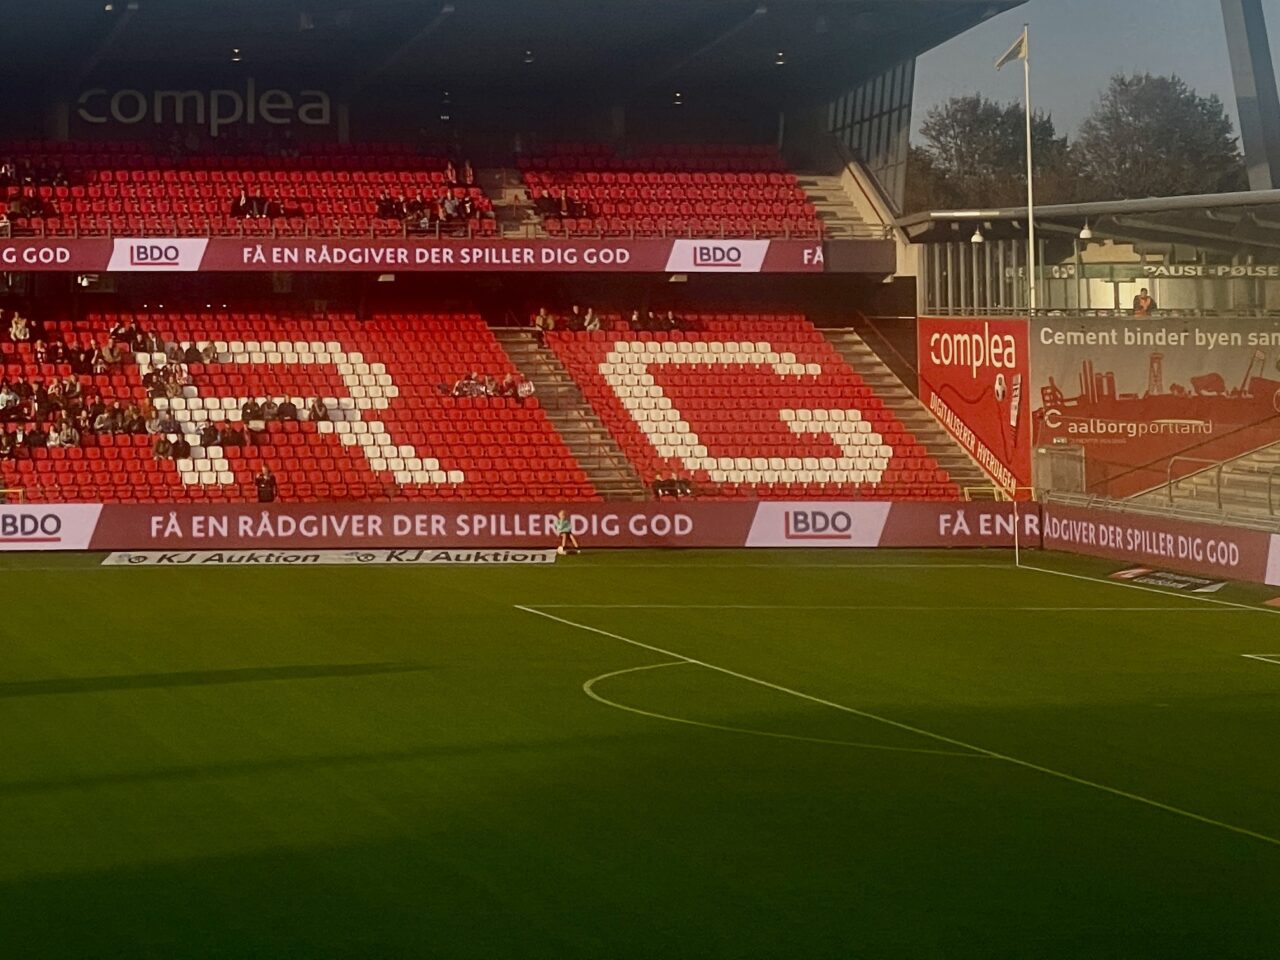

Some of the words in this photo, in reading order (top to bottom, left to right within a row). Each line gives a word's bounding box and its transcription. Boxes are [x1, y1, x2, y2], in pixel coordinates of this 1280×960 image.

[78, 78, 331, 137] complea
[22, 247, 71, 264] GOD
[136, 245, 180, 262] BDO
[243, 244, 267, 264] FÅ
[272, 247, 299, 264] EN
[305, 244, 409, 264] RÅDGIVER
[415, 247, 454, 264] DER
[460, 247, 535, 264] SPILLER
[541, 247, 578, 264] DIG
[583, 248, 630, 264] GOD
[700, 246, 742, 263] BDO
[803, 246, 824, 265] FÅ
[930, 321, 1016, 379] complea
[1040, 327, 1118, 345] Cement
[1124, 328, 1189, 346] binder
[1195, 328, 1241, 350] byen
[929, 391, 976, 453] DIGITALISERER
[976, 440, 1017, 496] HVERDAGEN
[1, 513, 62, 536] BDO
[151, 511, 183, 538] FÅ
[191, 515, 228, 538] EN
[238, 511, 384, 537] RÅDGIVER
[393, 514, 447, 537] DER
[456, 514, 560, 537] SPILLER
[570, 514, 620, 536] DIG
[628, 513, 693, 536] GOD
[793, 510, 852, 533] BDO
[939, 509, 971, 536] FÅ
[979, 513, 1015, 536] EN
[1099, 524, 1124, 550] DER
[1126, 528, 1174, 557] SPILLER
[1178, 536, 1203, 563] DIG
[1206, 539, 1239, 566] GOD
[156, 553, 197, 564] KJ
[201, 551, 320, 564] Auktion
[429, 551, 548, 563] Auktion
